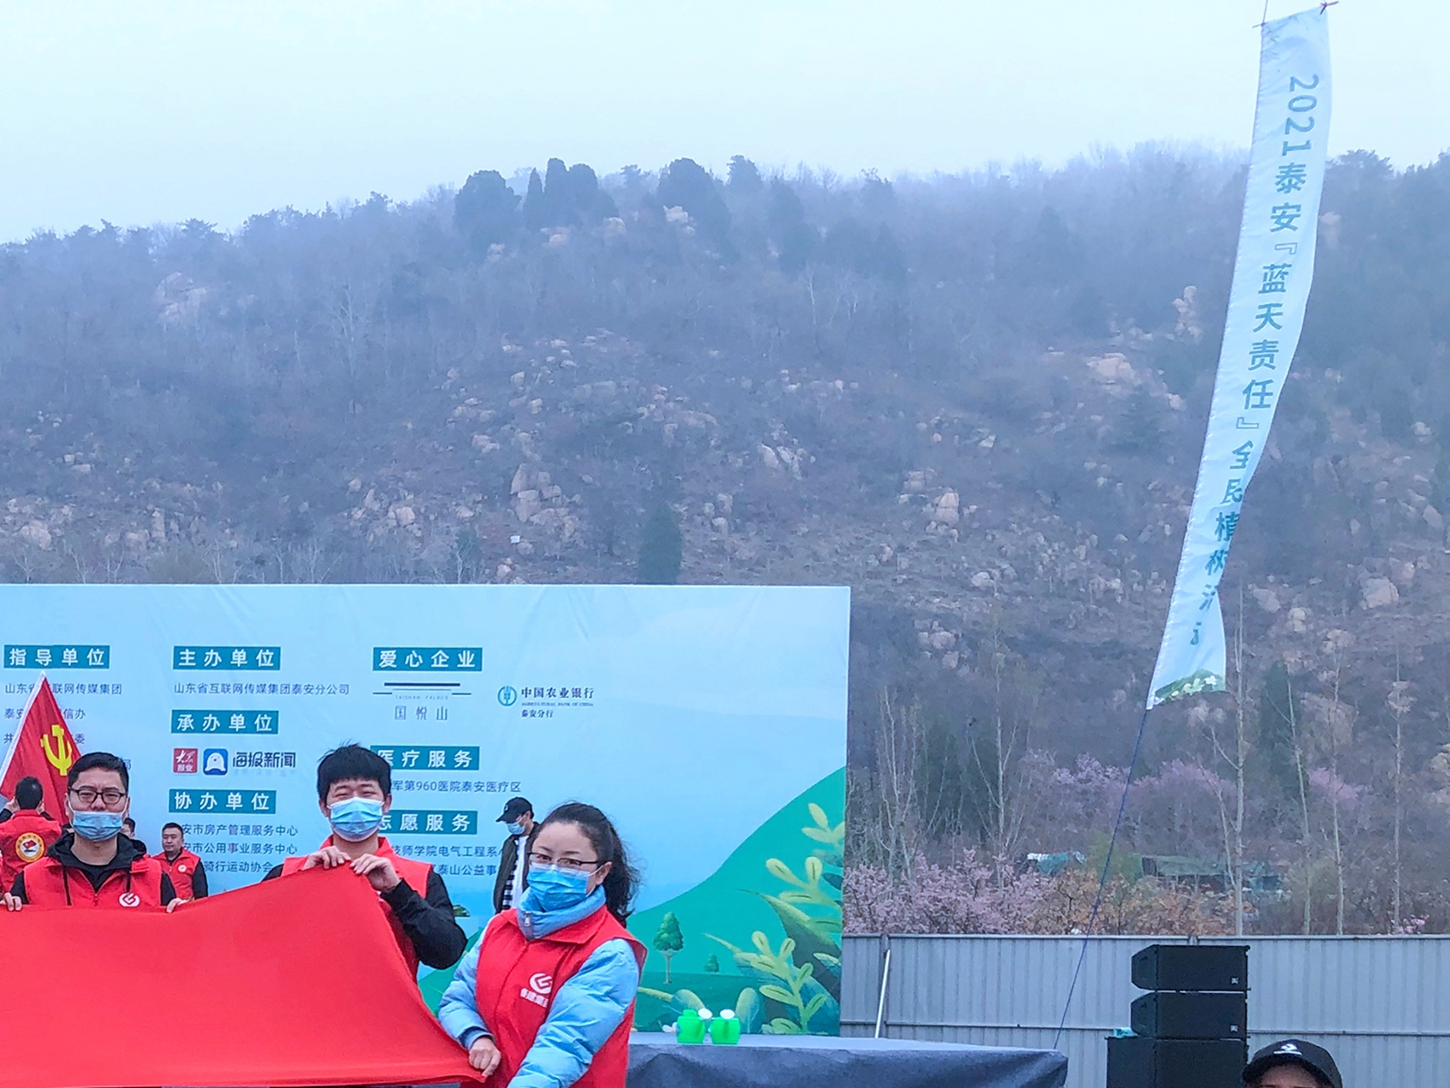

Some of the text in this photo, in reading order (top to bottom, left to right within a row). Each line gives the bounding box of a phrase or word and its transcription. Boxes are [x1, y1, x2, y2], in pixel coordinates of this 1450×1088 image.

[9, 648, 105, 667] 指导单位
[177, 648, 275, 668] 主办单位
[378, 649, 476, 668] 爱心企业
[5, 683, 123, 695] 山东联网传媒集团
[174, 682, 350, 695] 山东省互联网传媒集团泰安分公司
[521, 686, 594, 699] 中国农业银行
[176, 713, 273, 732] 承办单位
[232, 751, 297, 768] 海报新闻
[377, 749, 473, 768] 医疗服务
[174, 791, 270, 810] 协办单位
[392, 845, 501, 858] 技师学院电气工程系
[432, 863, 497, 876] 泰山公益事
